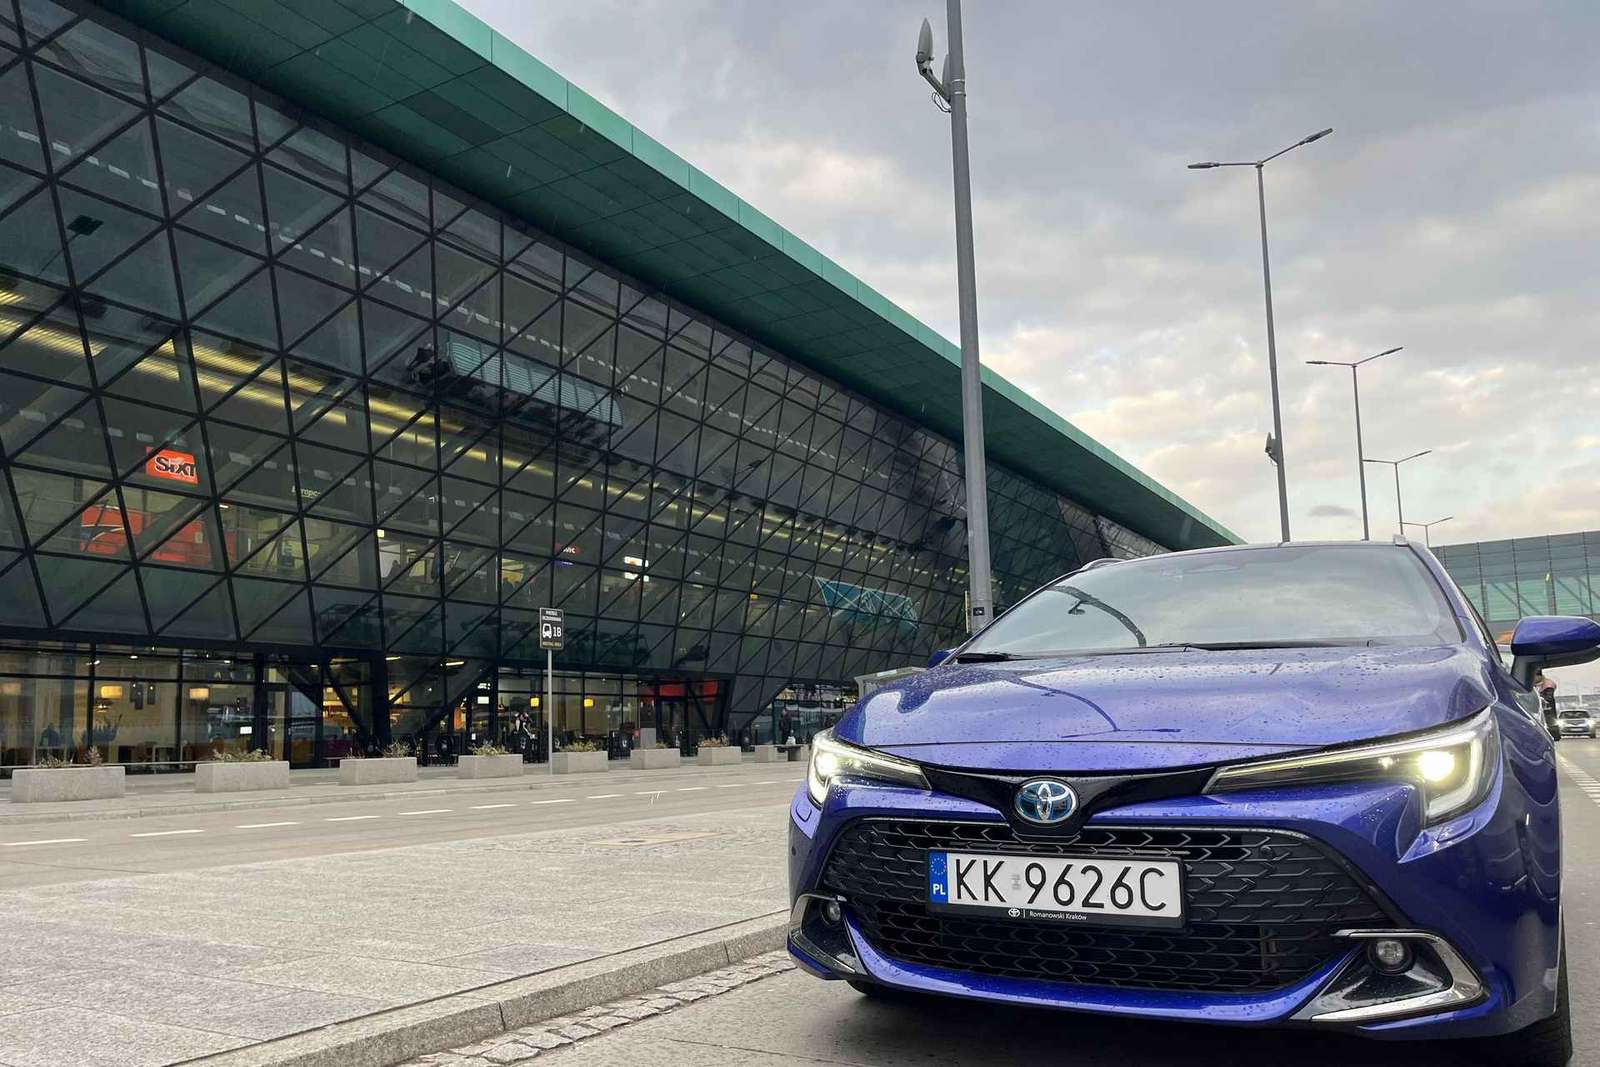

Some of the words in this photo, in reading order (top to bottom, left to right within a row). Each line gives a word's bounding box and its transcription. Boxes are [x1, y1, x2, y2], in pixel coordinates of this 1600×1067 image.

[932, 883, 946, 895] PL
[955, 859, 1007, 903] KK
[1024, 862, 1167, 911] 9626C
[1029, 910, 1065, 920] Romanowski
[1065, 912, 1088, 921] Kraków
